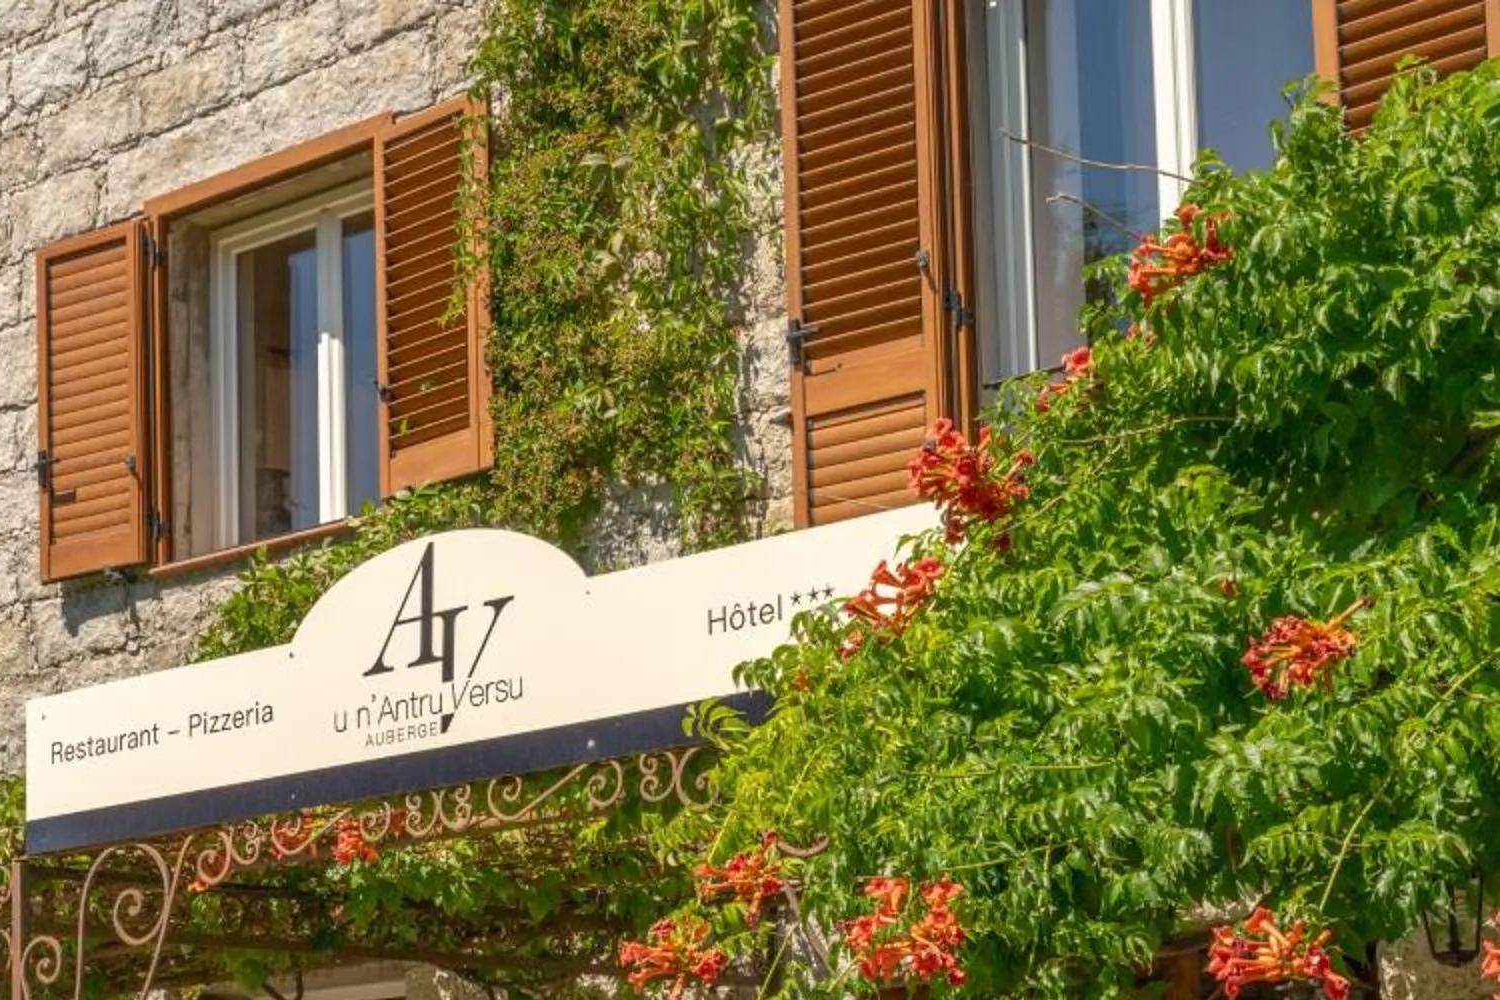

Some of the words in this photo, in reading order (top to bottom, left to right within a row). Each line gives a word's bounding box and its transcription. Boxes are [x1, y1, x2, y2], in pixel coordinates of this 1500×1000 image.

[706, 592, 784, 636] Hôtel
[450, 675, 524, 711] Versu
[50, 722, 160, 765] Restaurant
[188, 700, 275, 737] Pizzeria
[364, 722, 439, 748] AUBERGE
